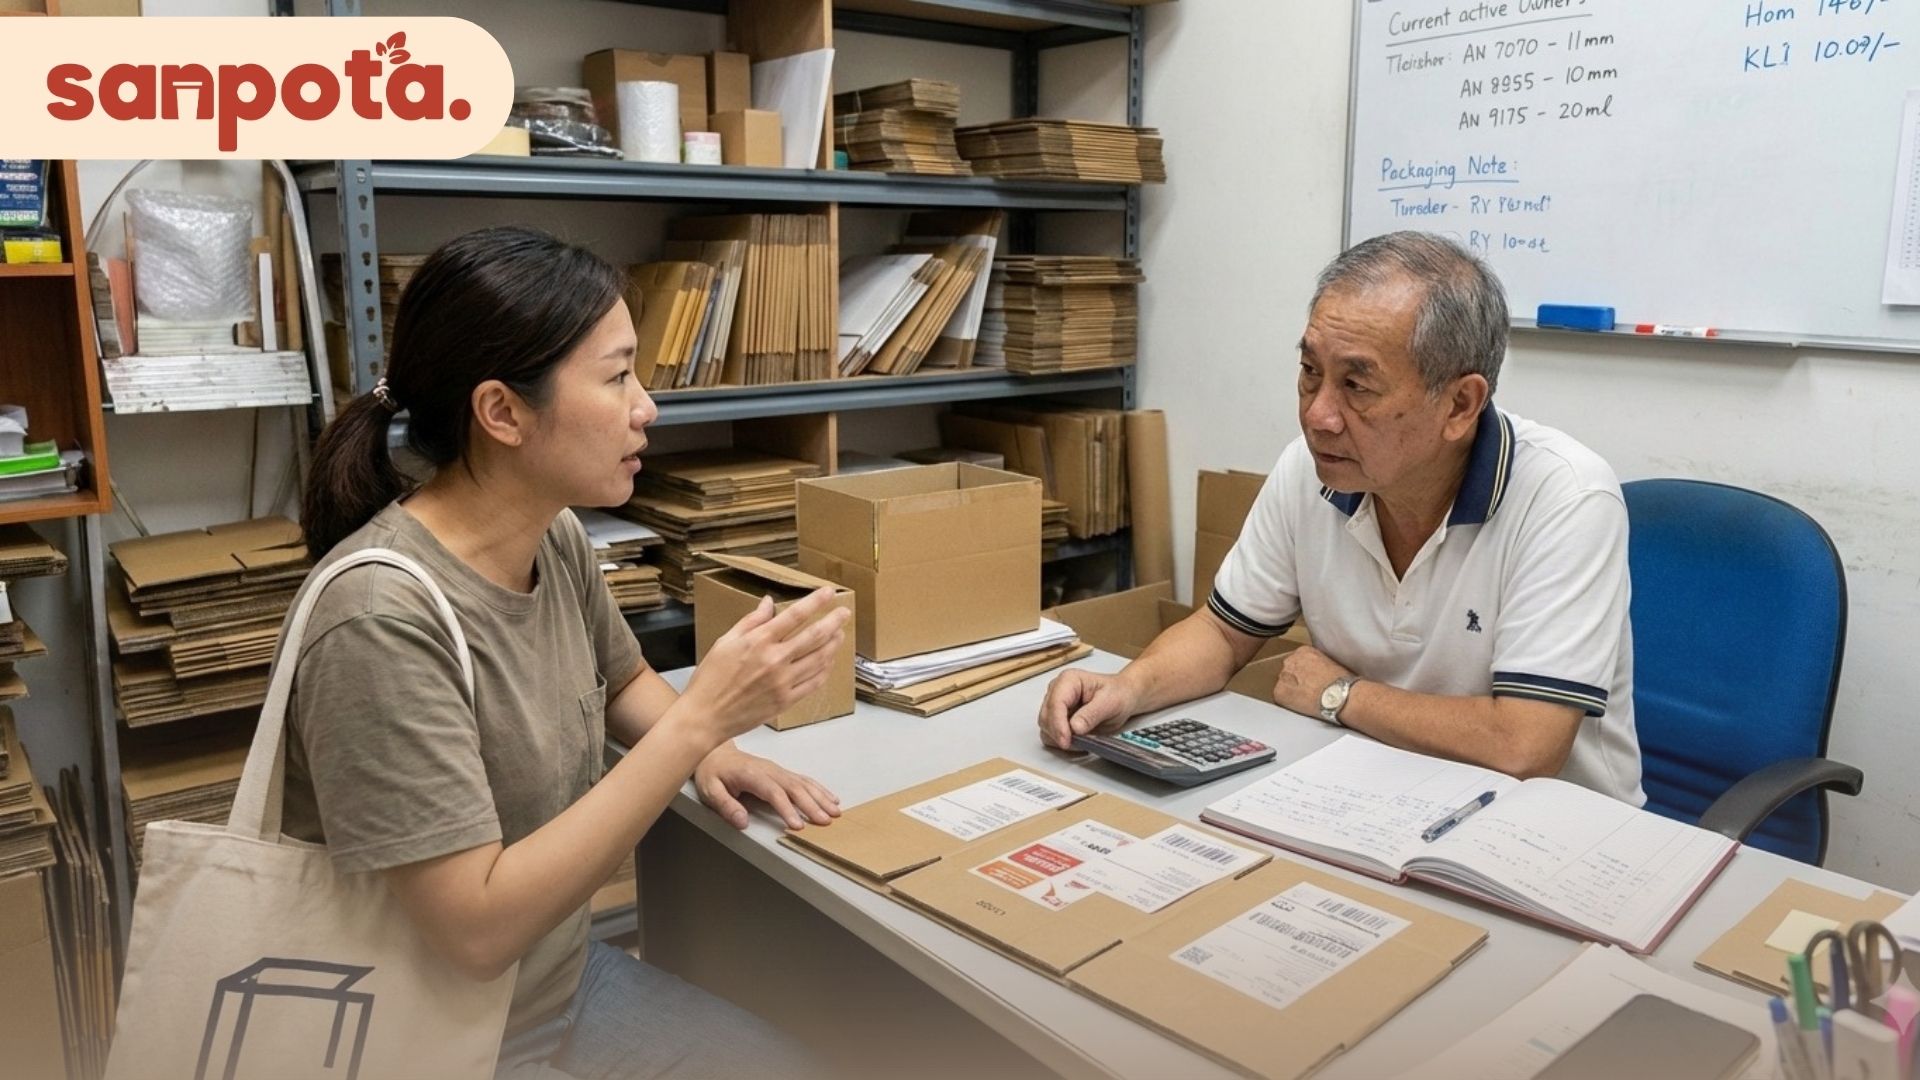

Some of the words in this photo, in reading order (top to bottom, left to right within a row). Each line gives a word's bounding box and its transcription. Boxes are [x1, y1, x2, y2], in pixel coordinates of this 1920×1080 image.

[1388, 7, 1451, 36] Current
[1459, 2, 1508, 22] active
[1746, 0, 1794, 27] Hom
[1463, 43, 1486, 64] AN
[1494, 38, 1538, 59] 7070
[1460, 79, 1482, 98] AN
[1459, 111, 1480, 130] AN
[1488, 106, 1529, 128] 9175
[1381, 157, 1456, 189] Packaging
[1470, 195, 1491, 214] RY
[1470, 230, 1491, 251] RY
